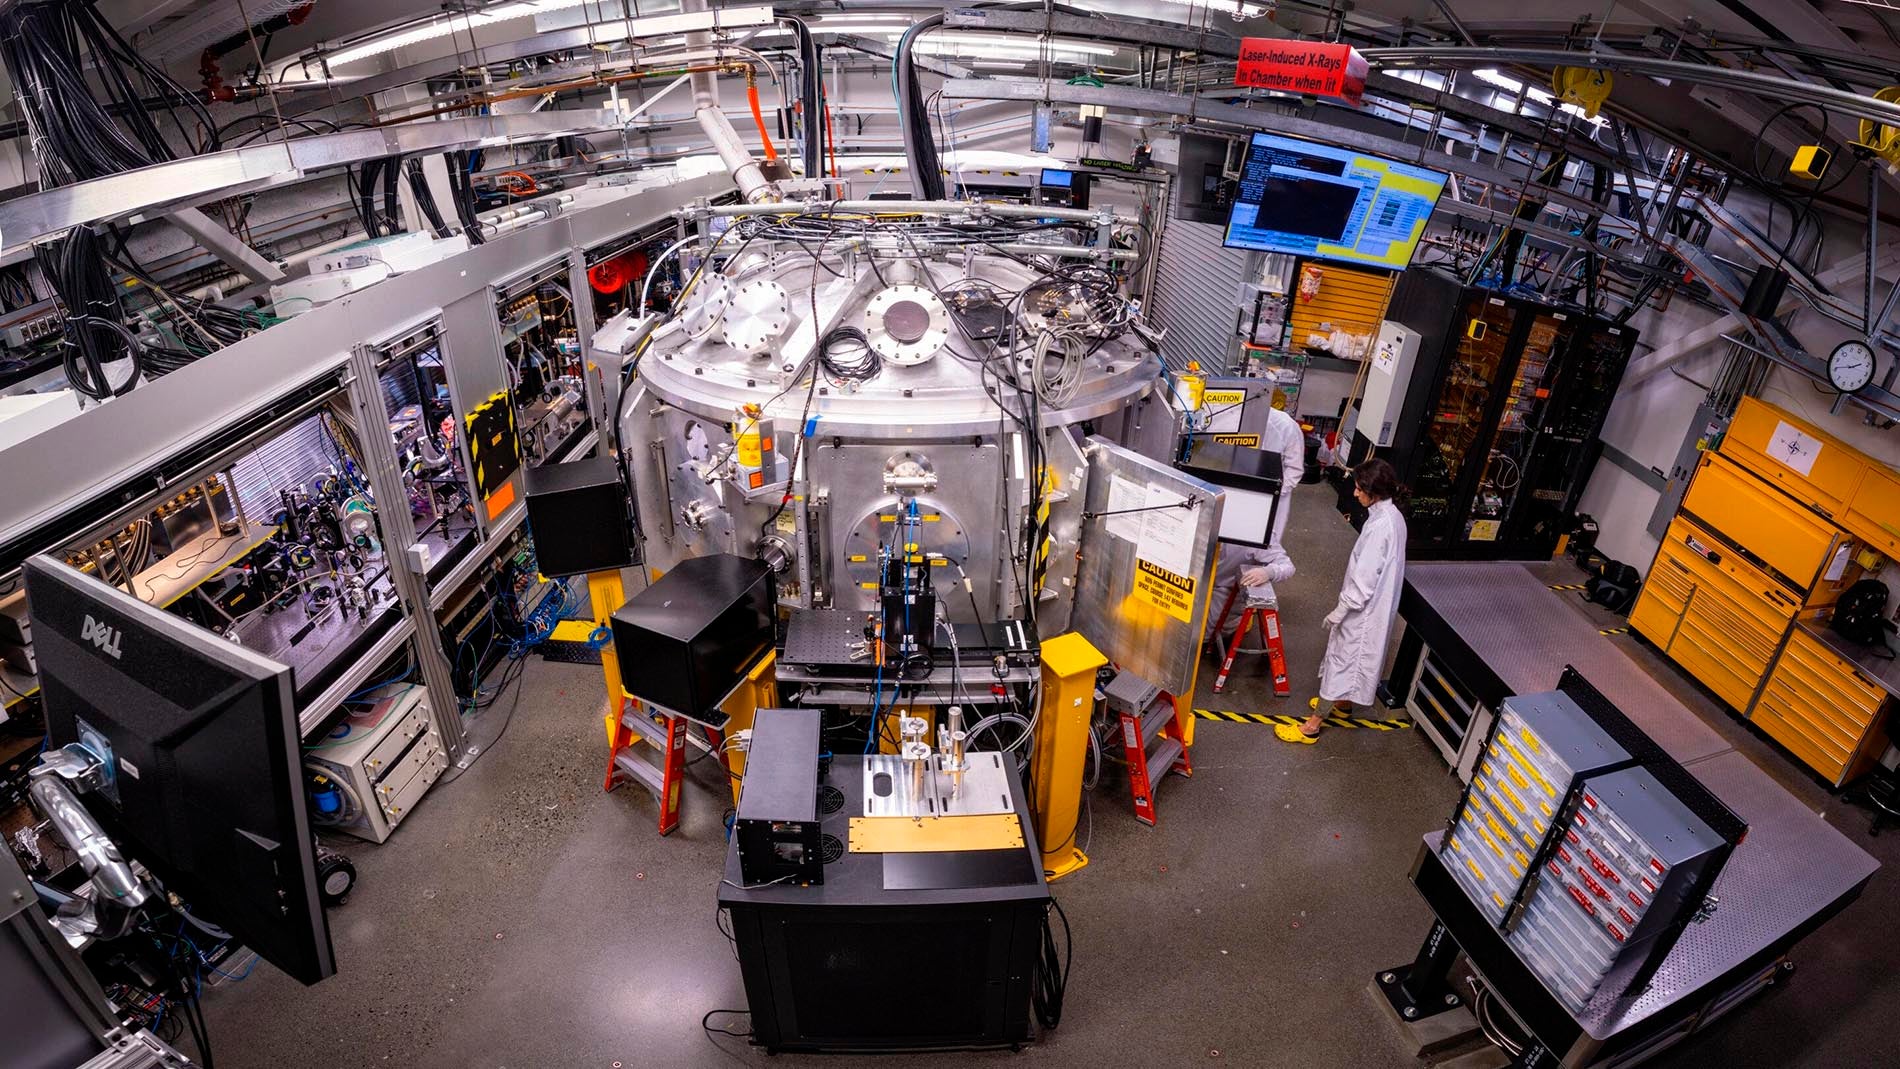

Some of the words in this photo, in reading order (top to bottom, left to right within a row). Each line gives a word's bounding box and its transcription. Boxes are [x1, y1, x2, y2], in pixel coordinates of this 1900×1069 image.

[1242, 47, 1306, 66] Laser-Induced
[1307, 53, 1342, 73] X-Rays
[1250, 68, 1293, 87] Chamber
[1295, 75, 1323, 91] when
[1324, 75, 1337, 93] lit
[1206, 394, 1240, 402] CAUTION
[1142, 559, 1190, 590] CAUTION
[80, 613, 123, 661] DELL
